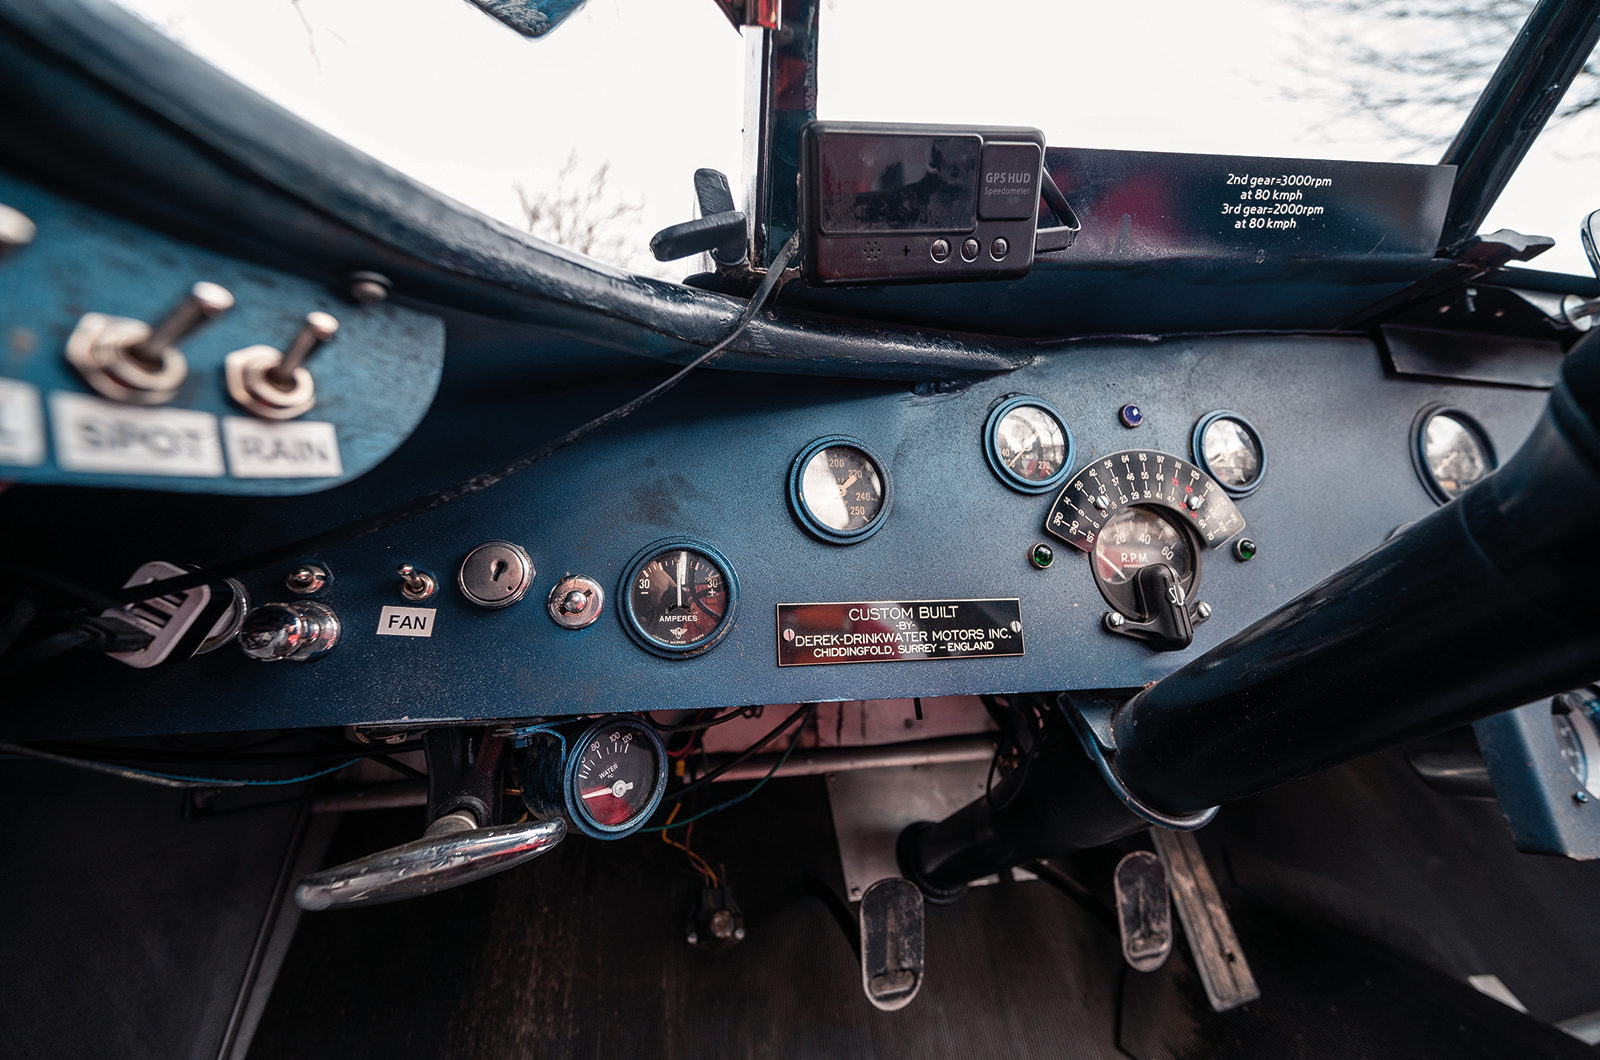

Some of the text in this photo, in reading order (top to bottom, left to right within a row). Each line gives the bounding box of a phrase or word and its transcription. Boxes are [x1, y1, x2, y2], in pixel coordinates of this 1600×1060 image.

[986, 173, 1030, 183] GPS HUD
[1227, 174, 1333, 188] 2nd gear=3000rpm
[984, 187, 1029, 196] Speedometer
[1240, 189, 1302, 202] at 80 kmph
[1221, 203, 1324, 217] 3rd gear=2000rpm
[1235, 218, 1297, 230] at 80 kmph
[80, 417, 203, 459] SPOT
[241, 435, 329, 462] RAIN
[829, 459, 845, 468] 200
[1038, 461, 1050, 469] 270
[856, 492, 870, 501] 240
[1143, 490, 1152, 498] 35
[850, 506, 865, 516] 250
[1078, 508, 1085, 517] 9
[1092, 521, 1100, 529] 6
[1114, 532, 1126, 545] 20
[1138, 533, 1151, 545] 40
[1207, 531, 1215, 541] 70
[1121, 552, 1150, 562] R.P.M.
[1161, 546, 1174, 560] 60
[639, 579, 650, 589] 30
[707, 578, 718, 588] 30
[849, 606, 958, 621] CUSTOM BUILT
[388, 614, 427, 630] FAN
[896, 621, 916, 630] -BY-
[795, 628, 1012, 647] DEREK-DRINKWATER MOTORS INC.
[813, 646, 894, 658] CHIDDINGFOLD,
[897, 643, 937, 654] SURREY
[948, 641, 994, 652] ENGLAND
[609, 732, 620, 743] 100
[622, 733, 632, 743] 120
[591, 741, 600, 752] 80
[599, 763, 618, 779] WATER
